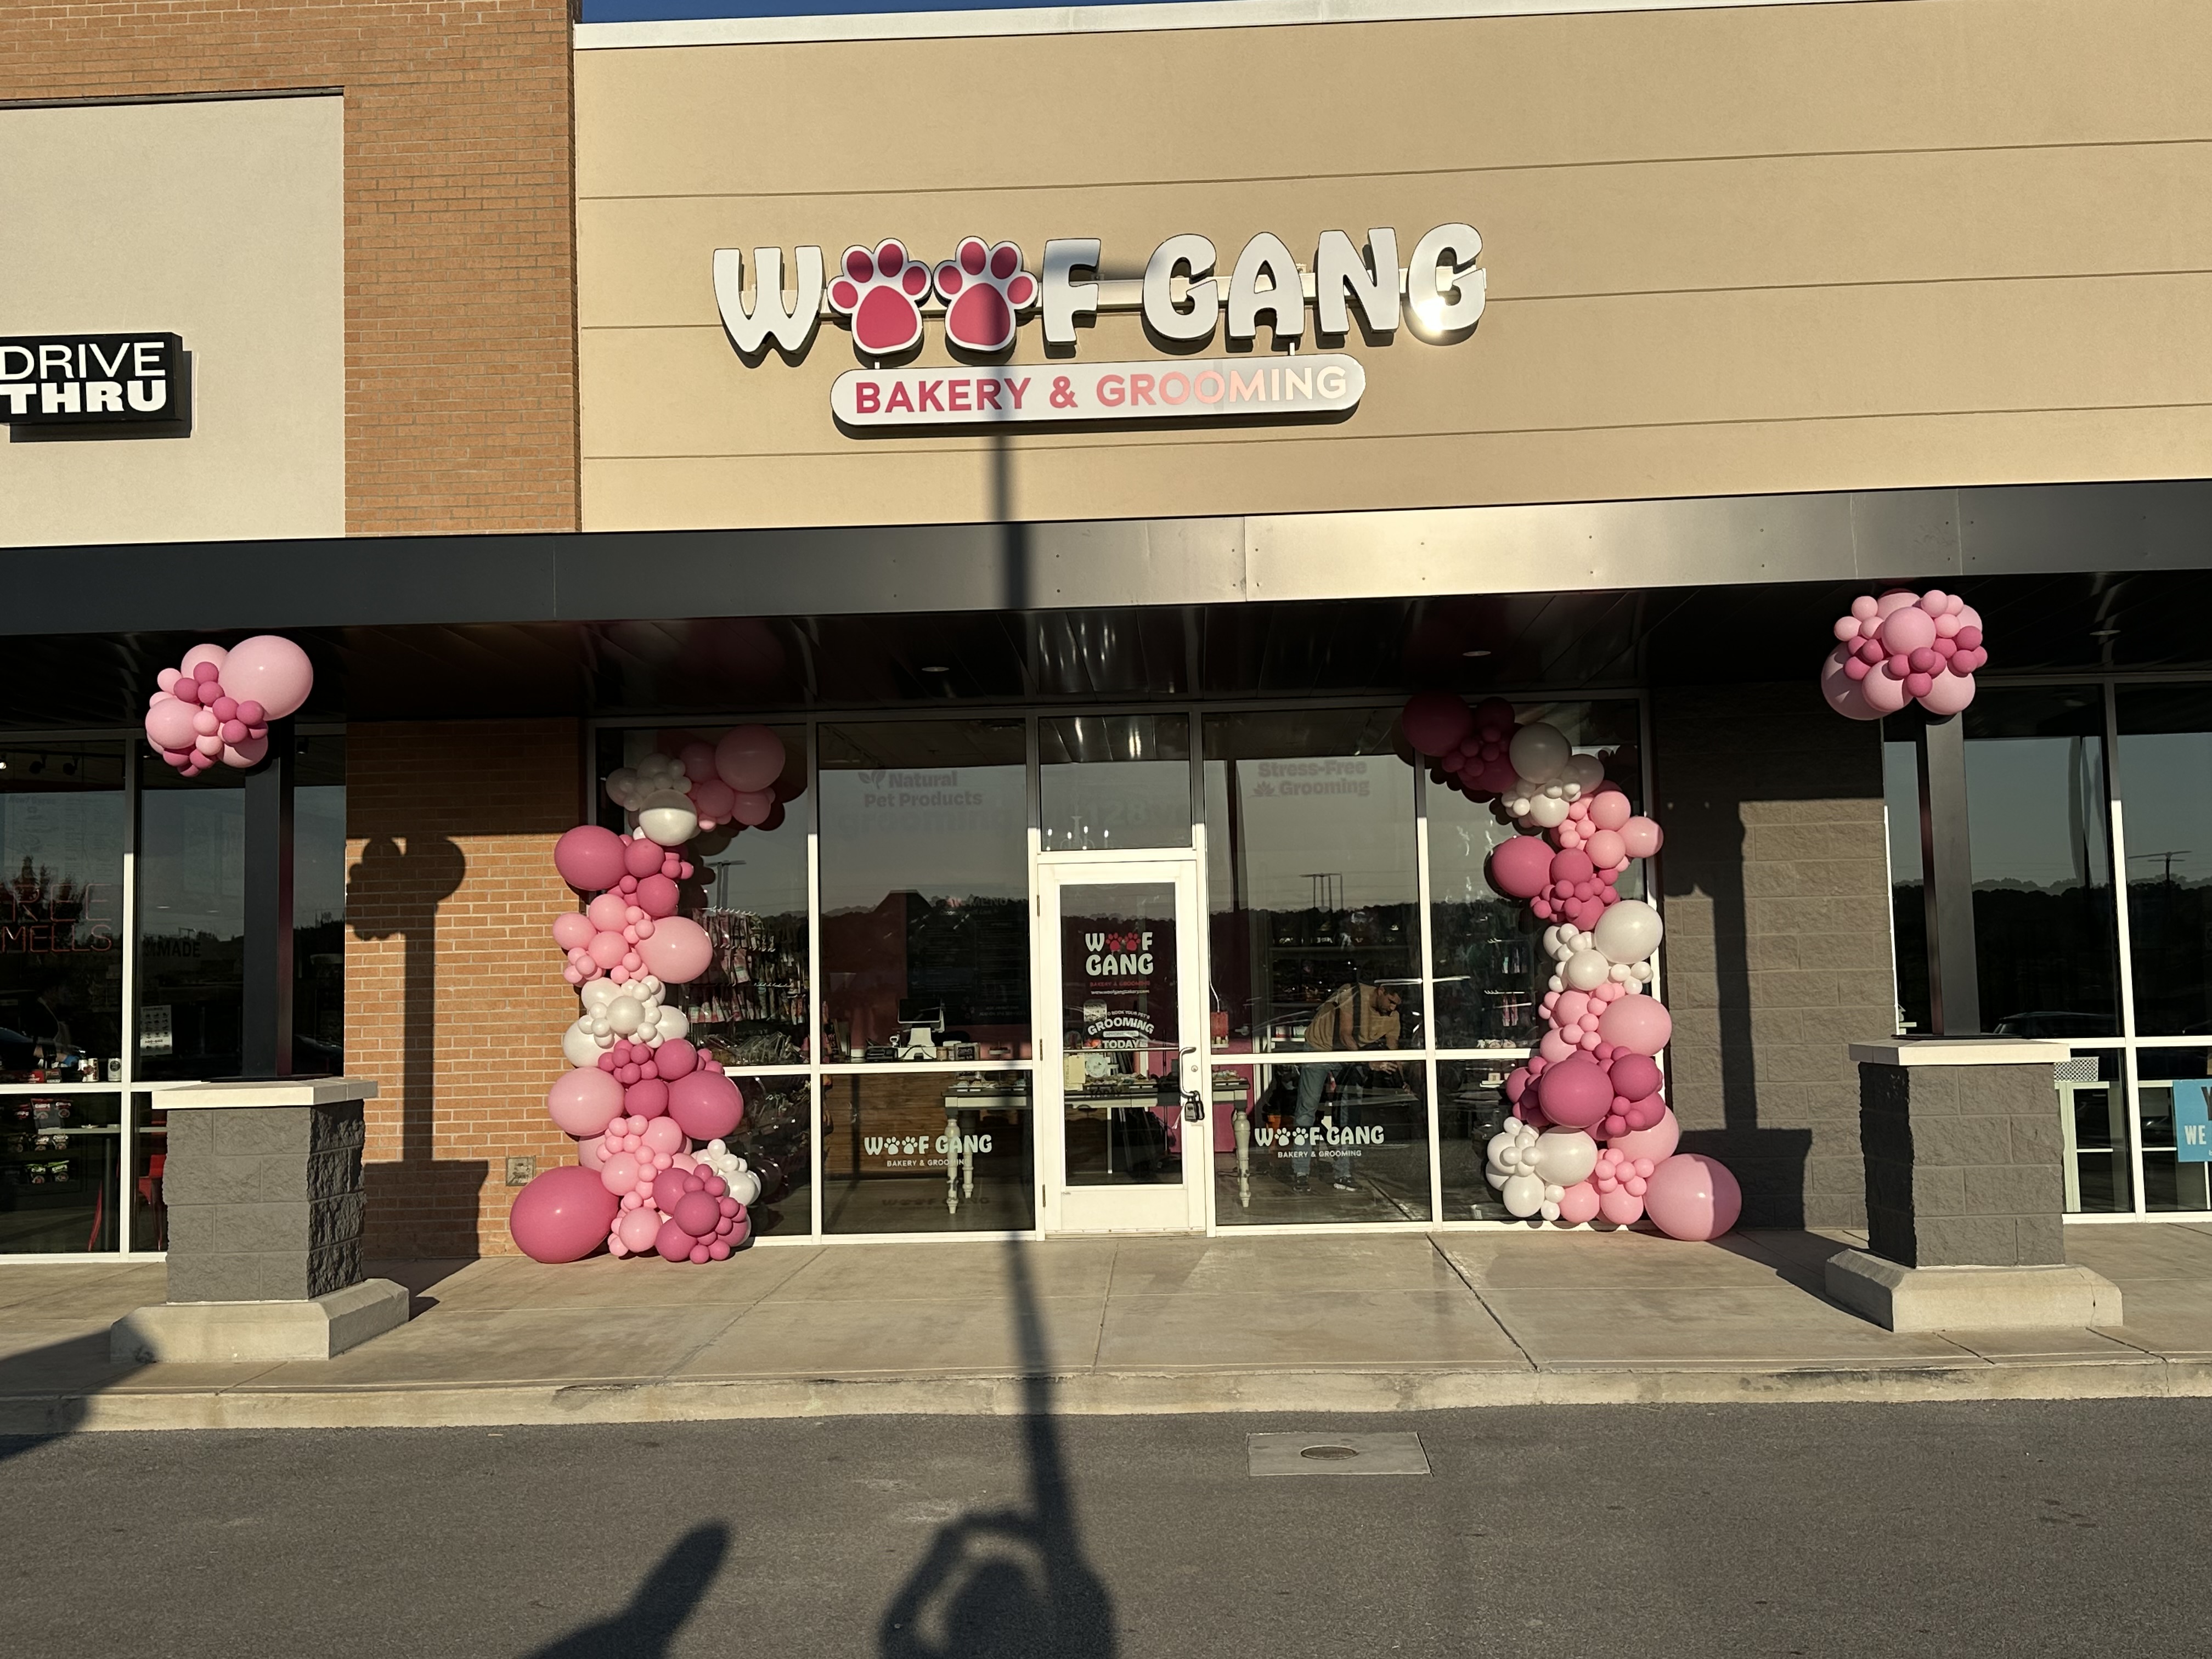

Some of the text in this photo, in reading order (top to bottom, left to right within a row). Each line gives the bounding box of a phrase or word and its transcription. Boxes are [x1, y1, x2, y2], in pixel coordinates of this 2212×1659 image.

[1142, 223, 1486, 341] GANG
[0, 342, 166, 380] DRIVE
[0, 380, 166, 415] THRU
[856, 366, 1347, 414] BAKERY & GROOMING
[1258, 759, 1368, 777] Stress-Free
[889, 771, 958, 788] Natural
[1279, 777, 1370, 797] Grooming
[864, 791, 983, 808] Pet Products
[0, 883, 112, 922] REE
[0, 924, 112, 953] MELLS
[1086, 953, 1154, 976] GANG
[1087, 1017, 1154, 1035] GROOMING
[935, 1134, 992, 1154] GANG
[1327, 1125, 1385, 1146] GANG
[2185, 1125, 2207, 1145] WE
